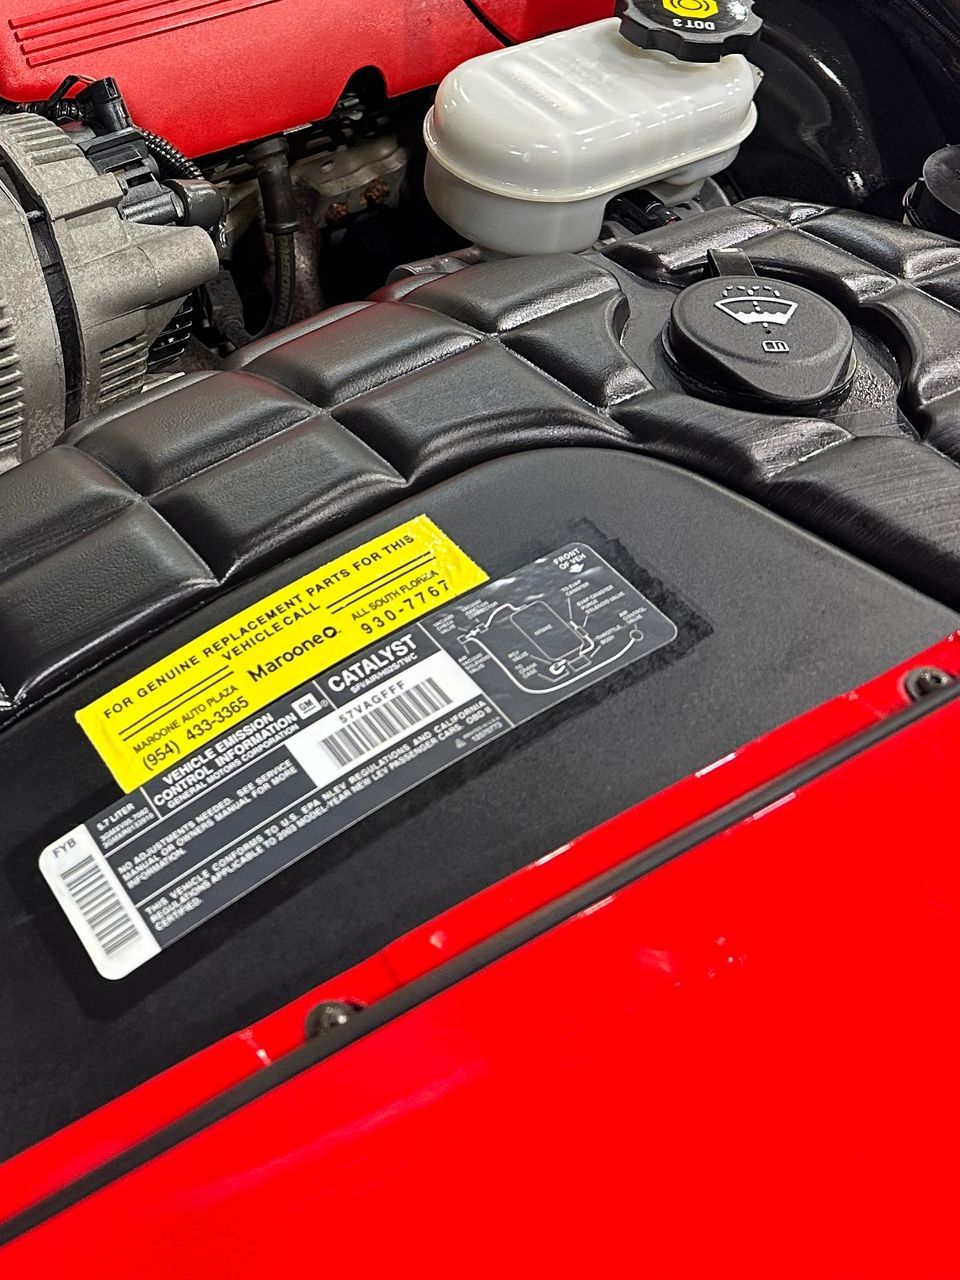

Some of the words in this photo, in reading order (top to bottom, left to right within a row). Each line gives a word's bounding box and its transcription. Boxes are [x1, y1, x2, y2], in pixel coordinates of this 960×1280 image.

[685, 19, 714, 28] DOT
[553, 548, 579, 565] FRONT
[558, 561, 570, 570] OF
[570, 553, 586, 564] VEH
[103, 696, 133, 718] FOR
[136, 654, 199, 698] GENUINE
[203, 593, 303, 657] REPLACEMENT
[307, 567, 350, 596] PARTS
[353, 551, 381, 570] FOR
[382, 533, 414, 555] THIS
[351, 606, 370, 620] ALL
[369, 589, 400, 610] SOUTH
[326, 633, 417, 693] CATALYST
[133, 720, 180, 753] MAROONE
[181, 703, 207, 723] AUTO
[207, 684, 237, 706] PLAZA
[141, 738, 181, 771] (954)
[184, 695, 249, 741] 433-3365
[297, 697, 313, 711] GM
[152, 763, 213, 806] CONTROL
[214, 711, 297, 767] INFORMATION
[163, 747, 216, 786] VEHICLE
[215, 712, 273, 753] EMISSION
[166, 780, 206, 808] GENERAL
[206, 758, 241, 783] MOTORS
[241, 722, 298, 762] CORPORATION
[109, 802, 135, 822] LITER
[117, 860, 132, 874] NO
[132, 820, 195, 864] ADJUSTMENTS
[195, 795, 233, 823] NEEDED.
[236, 782, 254, 797] SEE
[255, 758, 292, 785] SERVICE
[122, 853, 159, 881] MANUAL
[161, 843, 174, 855] OR
[175, 818, 214, 846] OWNERS
[214, 794, 251, 821] MANUAL
[251, 782, 271, 797] FOR
[271, 765, 297, 785] MORE
[144, 896, 167, 915] THIS
[169, 869, 210, 899] VEHICLE
[210, 834, 263, 872] CONFORMS
[265, 824, 279, 837] TO
[301, 798, 320, 814] EPA
[321, 781, 347, 801] NLEV
[348, 743, 410, 784] REGULATIONS
[412, 730, 431, 745] AND
[433, 699, 486, 733] CALIFORNIA
[148, 879, 211, 923] REGULATIONS
[210, 844, 263, 883] APPLICABLE
[263, 836, 277, 848] TO
[276, 823, 297, 840] 2003
[351, 776, 371, 793] NEW
[371, 766, 389, 781] LEV
[388, 736, 438, 770] PASSENGER
[465, 709, 486, 724] OBD
[52, 837, 76, 857] FYB
[126, 846, 187, 889] INFORMATION.
[153, 894, 204, 932] CERTIFIED.
